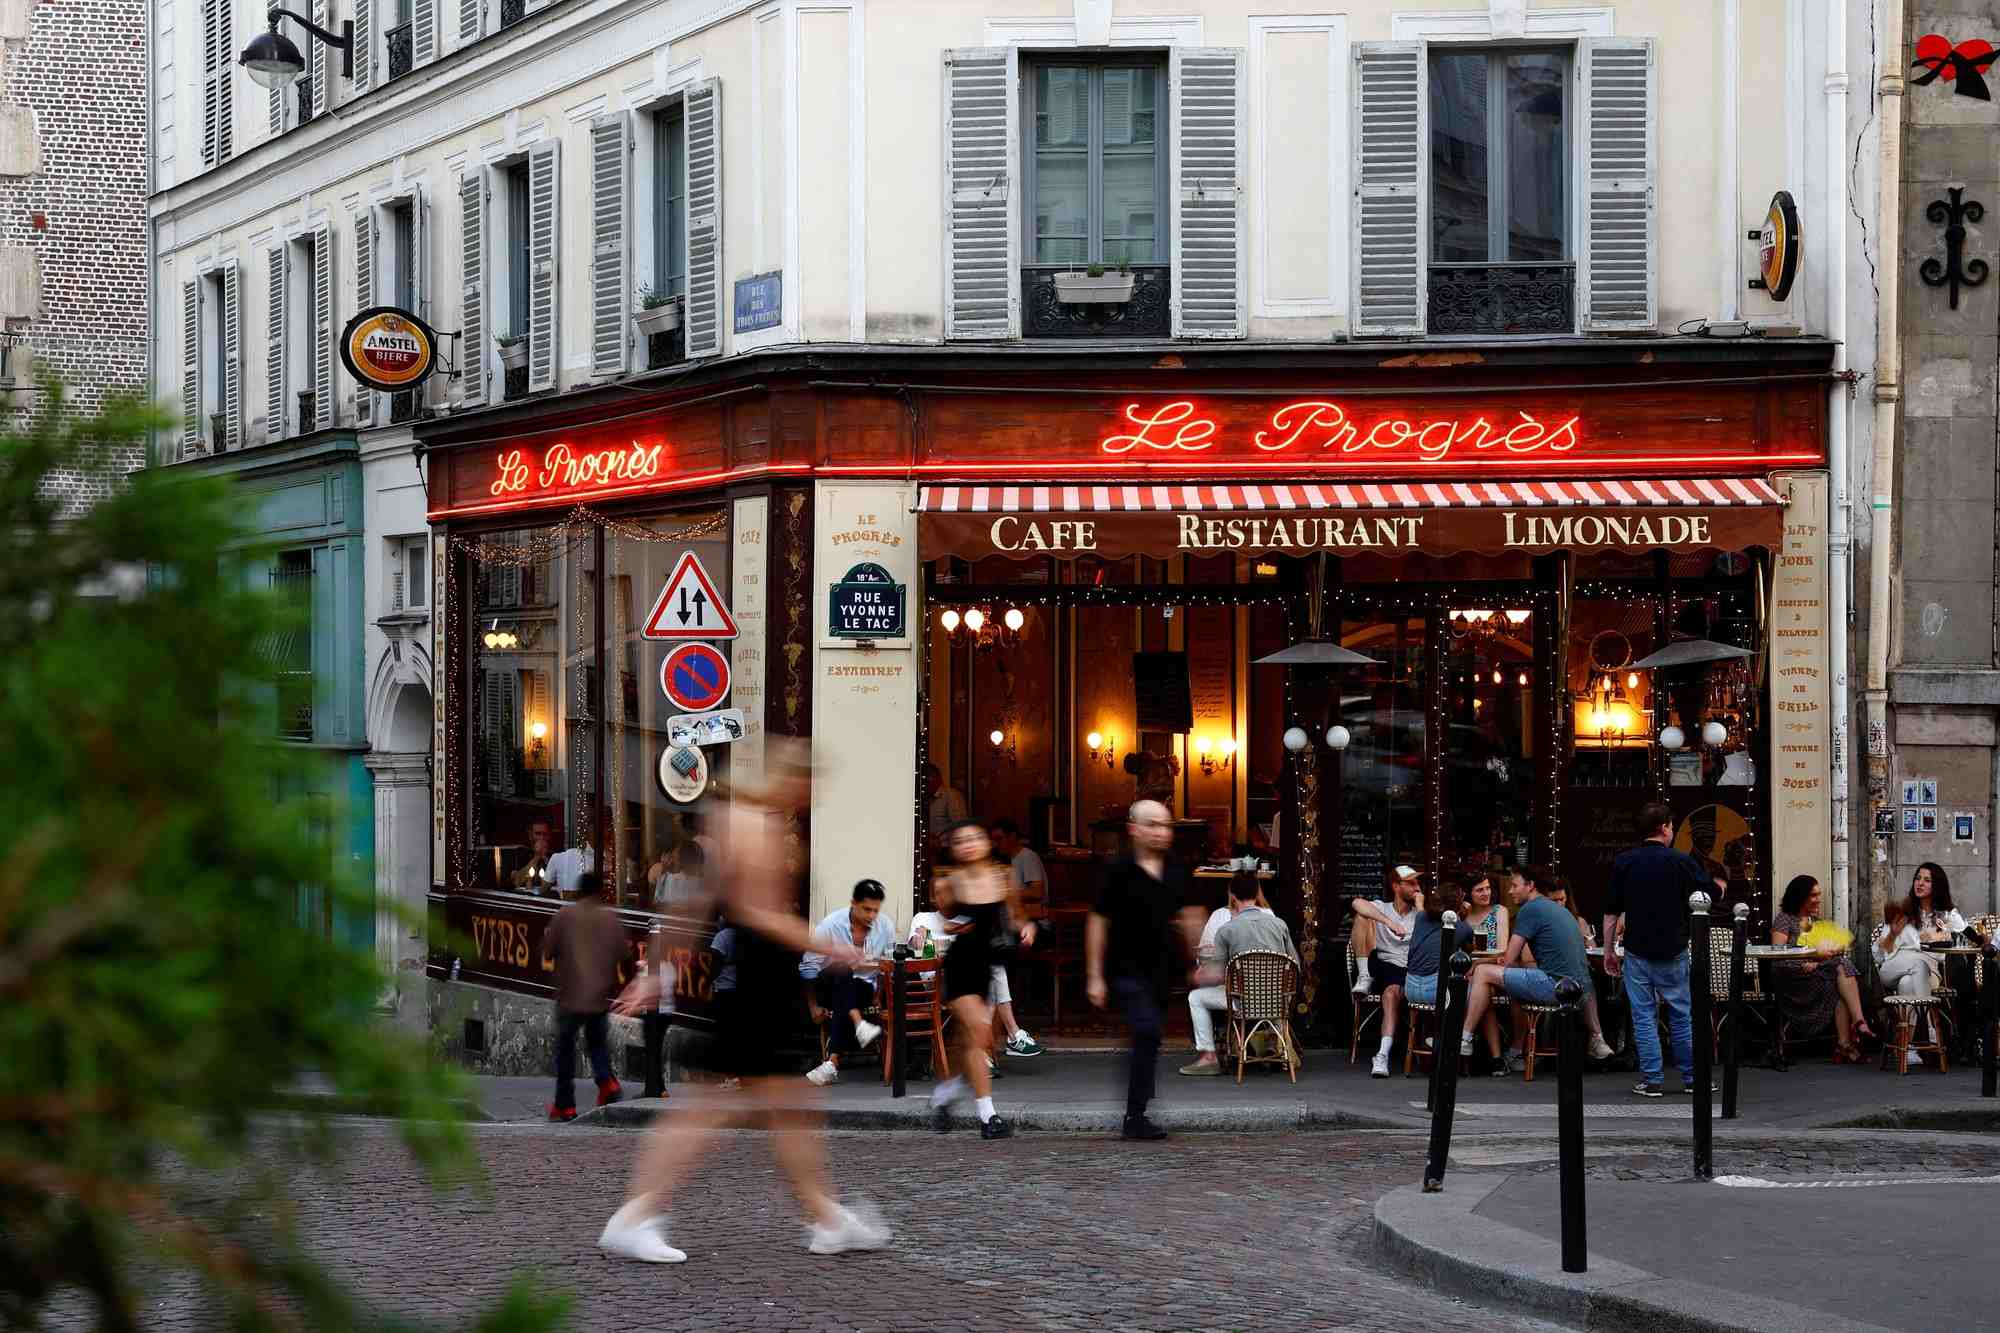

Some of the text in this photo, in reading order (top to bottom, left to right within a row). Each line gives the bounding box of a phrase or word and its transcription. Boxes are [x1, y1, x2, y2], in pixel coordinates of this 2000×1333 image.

[367, 335, 417, 351] AMSTEL
[1102, 400, 1580, 462] Le Progrès
[490, 439, 663, 496] Le Progrès
[990, 511, 1712, 551] CAFE RESTAURANT LIMONADE
[1782, 525, 1817, 537] LAT
[854, 591, 881, 604] RUE
[840, 604, 896, 617] YVONNE
[844, 617, 890, 629] LE TAC
